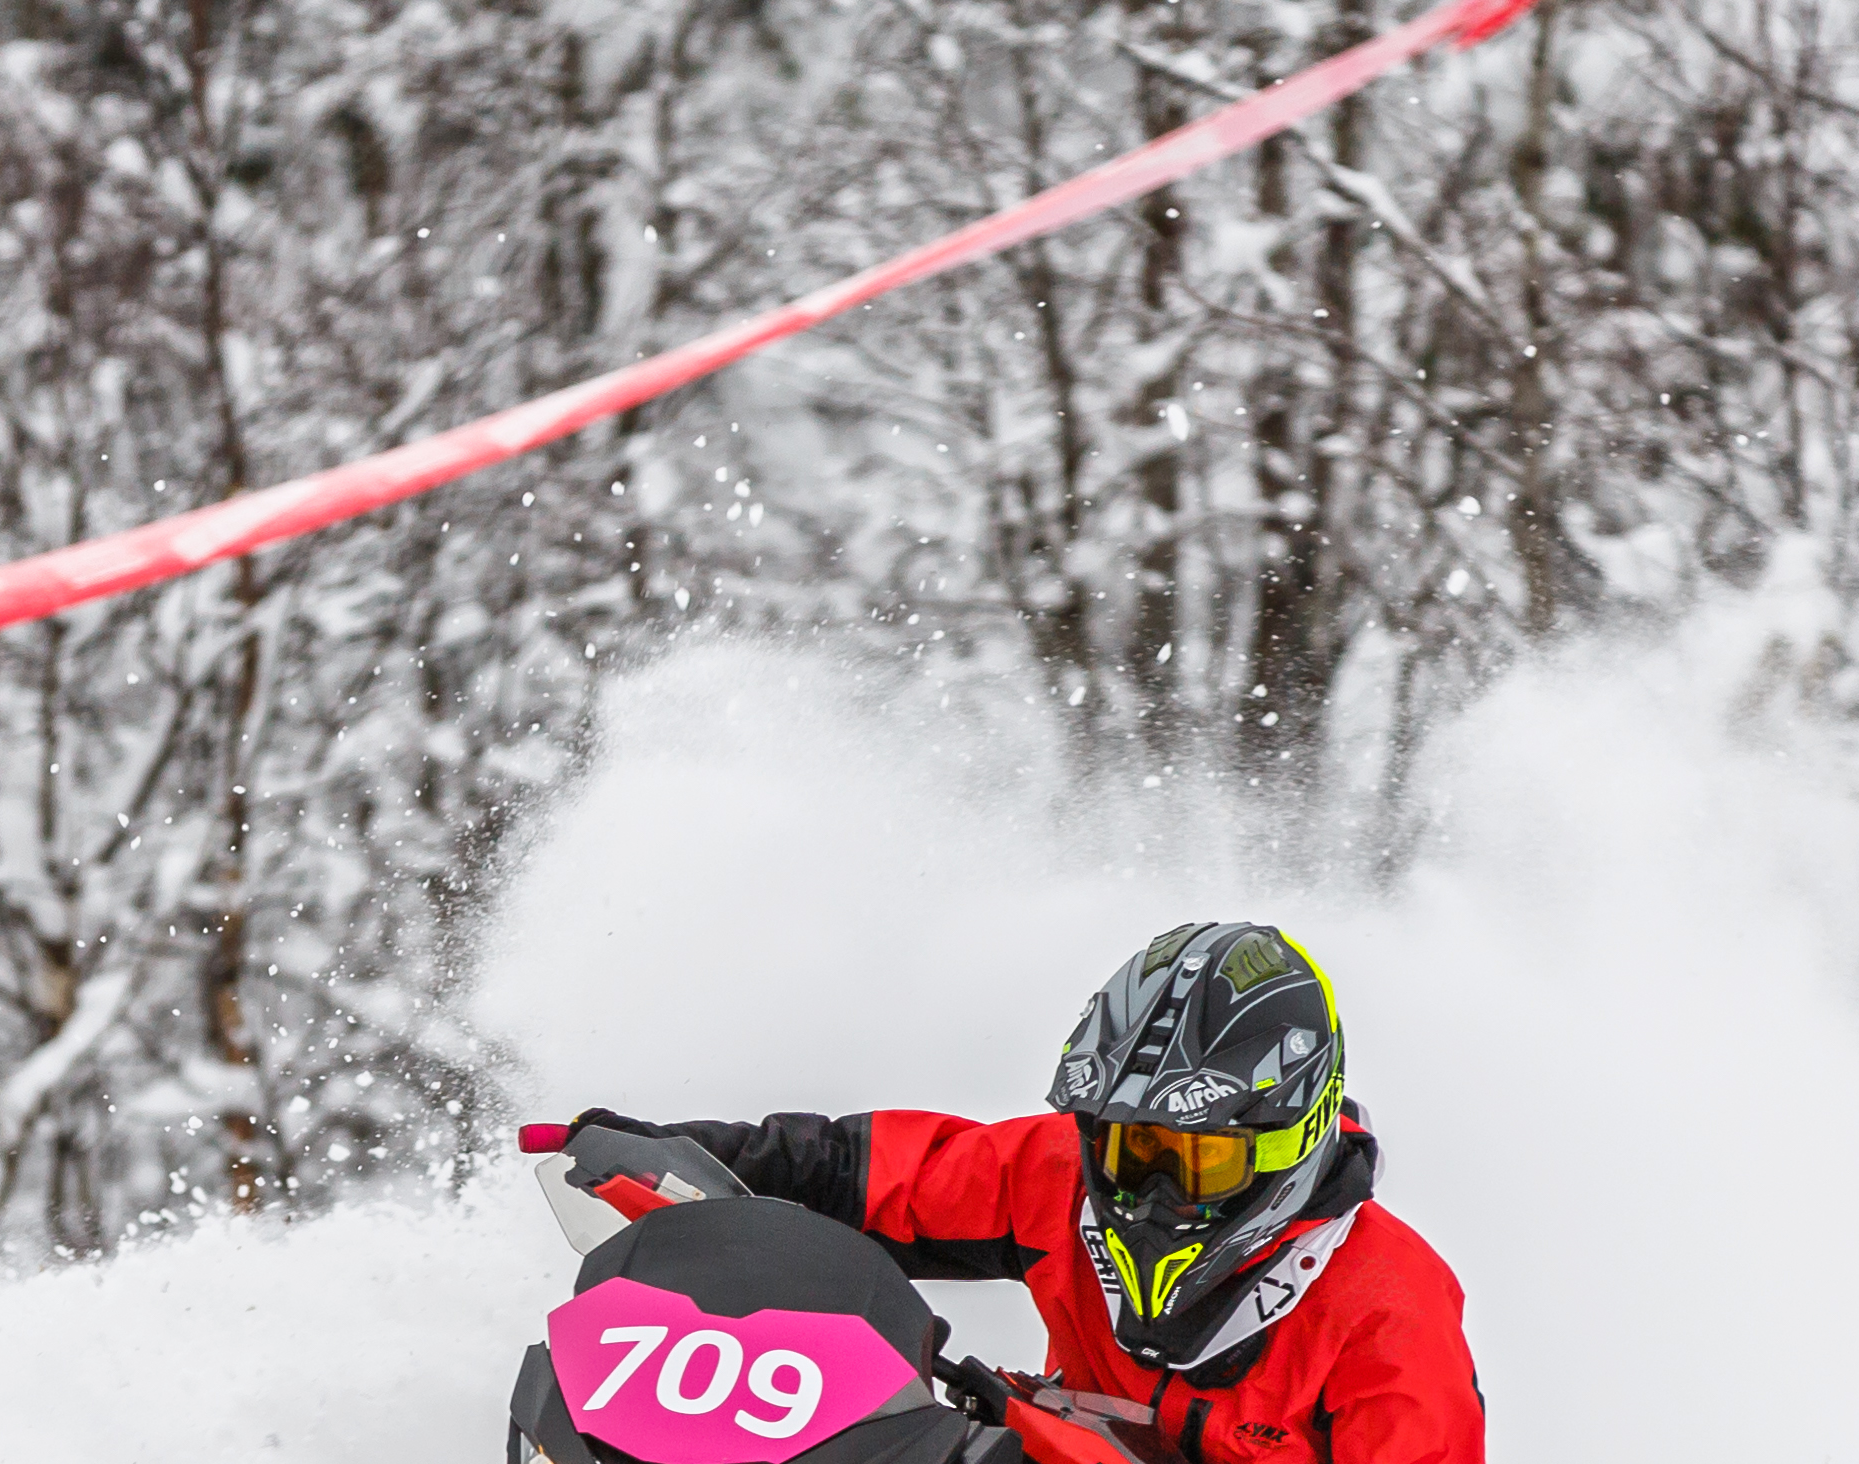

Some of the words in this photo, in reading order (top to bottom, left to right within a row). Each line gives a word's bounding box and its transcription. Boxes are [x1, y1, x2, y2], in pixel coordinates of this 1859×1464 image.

[1168, 1076, 1237, 1113] Airoh
[581, 1325, 823, 1439] 709
[1236, 1422, 1289, 1444] LYNX
